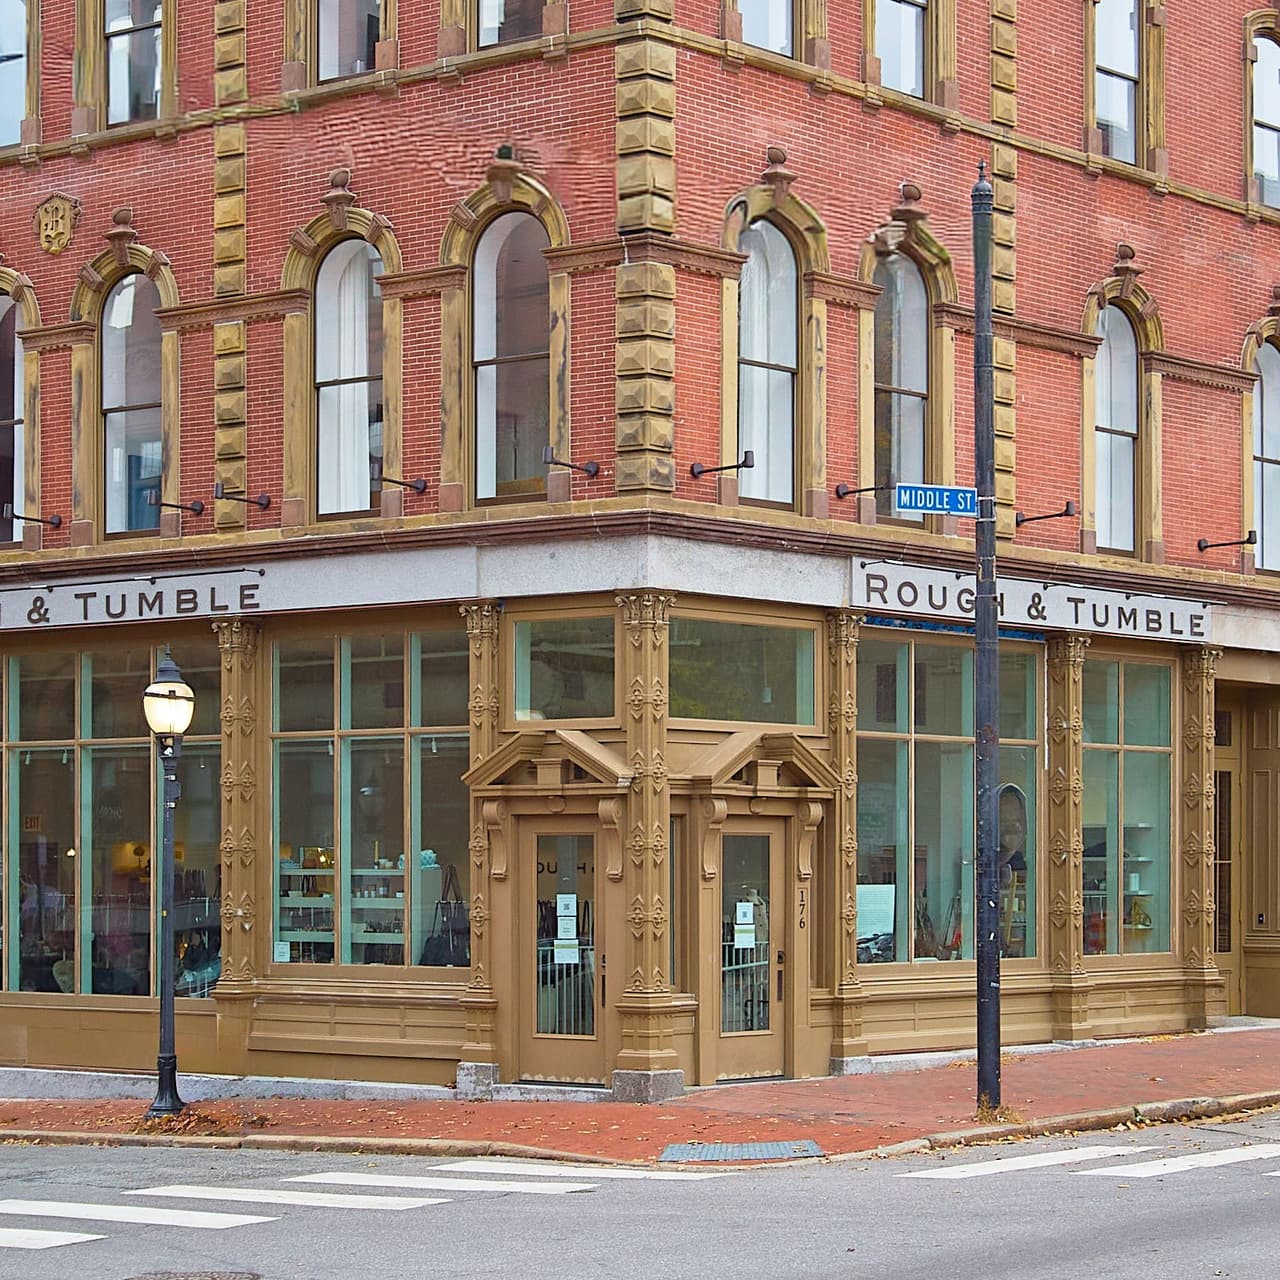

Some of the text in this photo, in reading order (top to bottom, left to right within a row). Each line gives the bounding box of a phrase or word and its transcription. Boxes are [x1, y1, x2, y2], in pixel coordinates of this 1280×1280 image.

[900, 485, 972, 510] MIDDLE ST
[27, 596, 49, 623] &
[74, 584, 260, 620] TUMBLE
[1027, 592, 1047, 621] &
[1067, 597, 1205, 637] TUMBLE
[798, 890, 807, 929] 176
